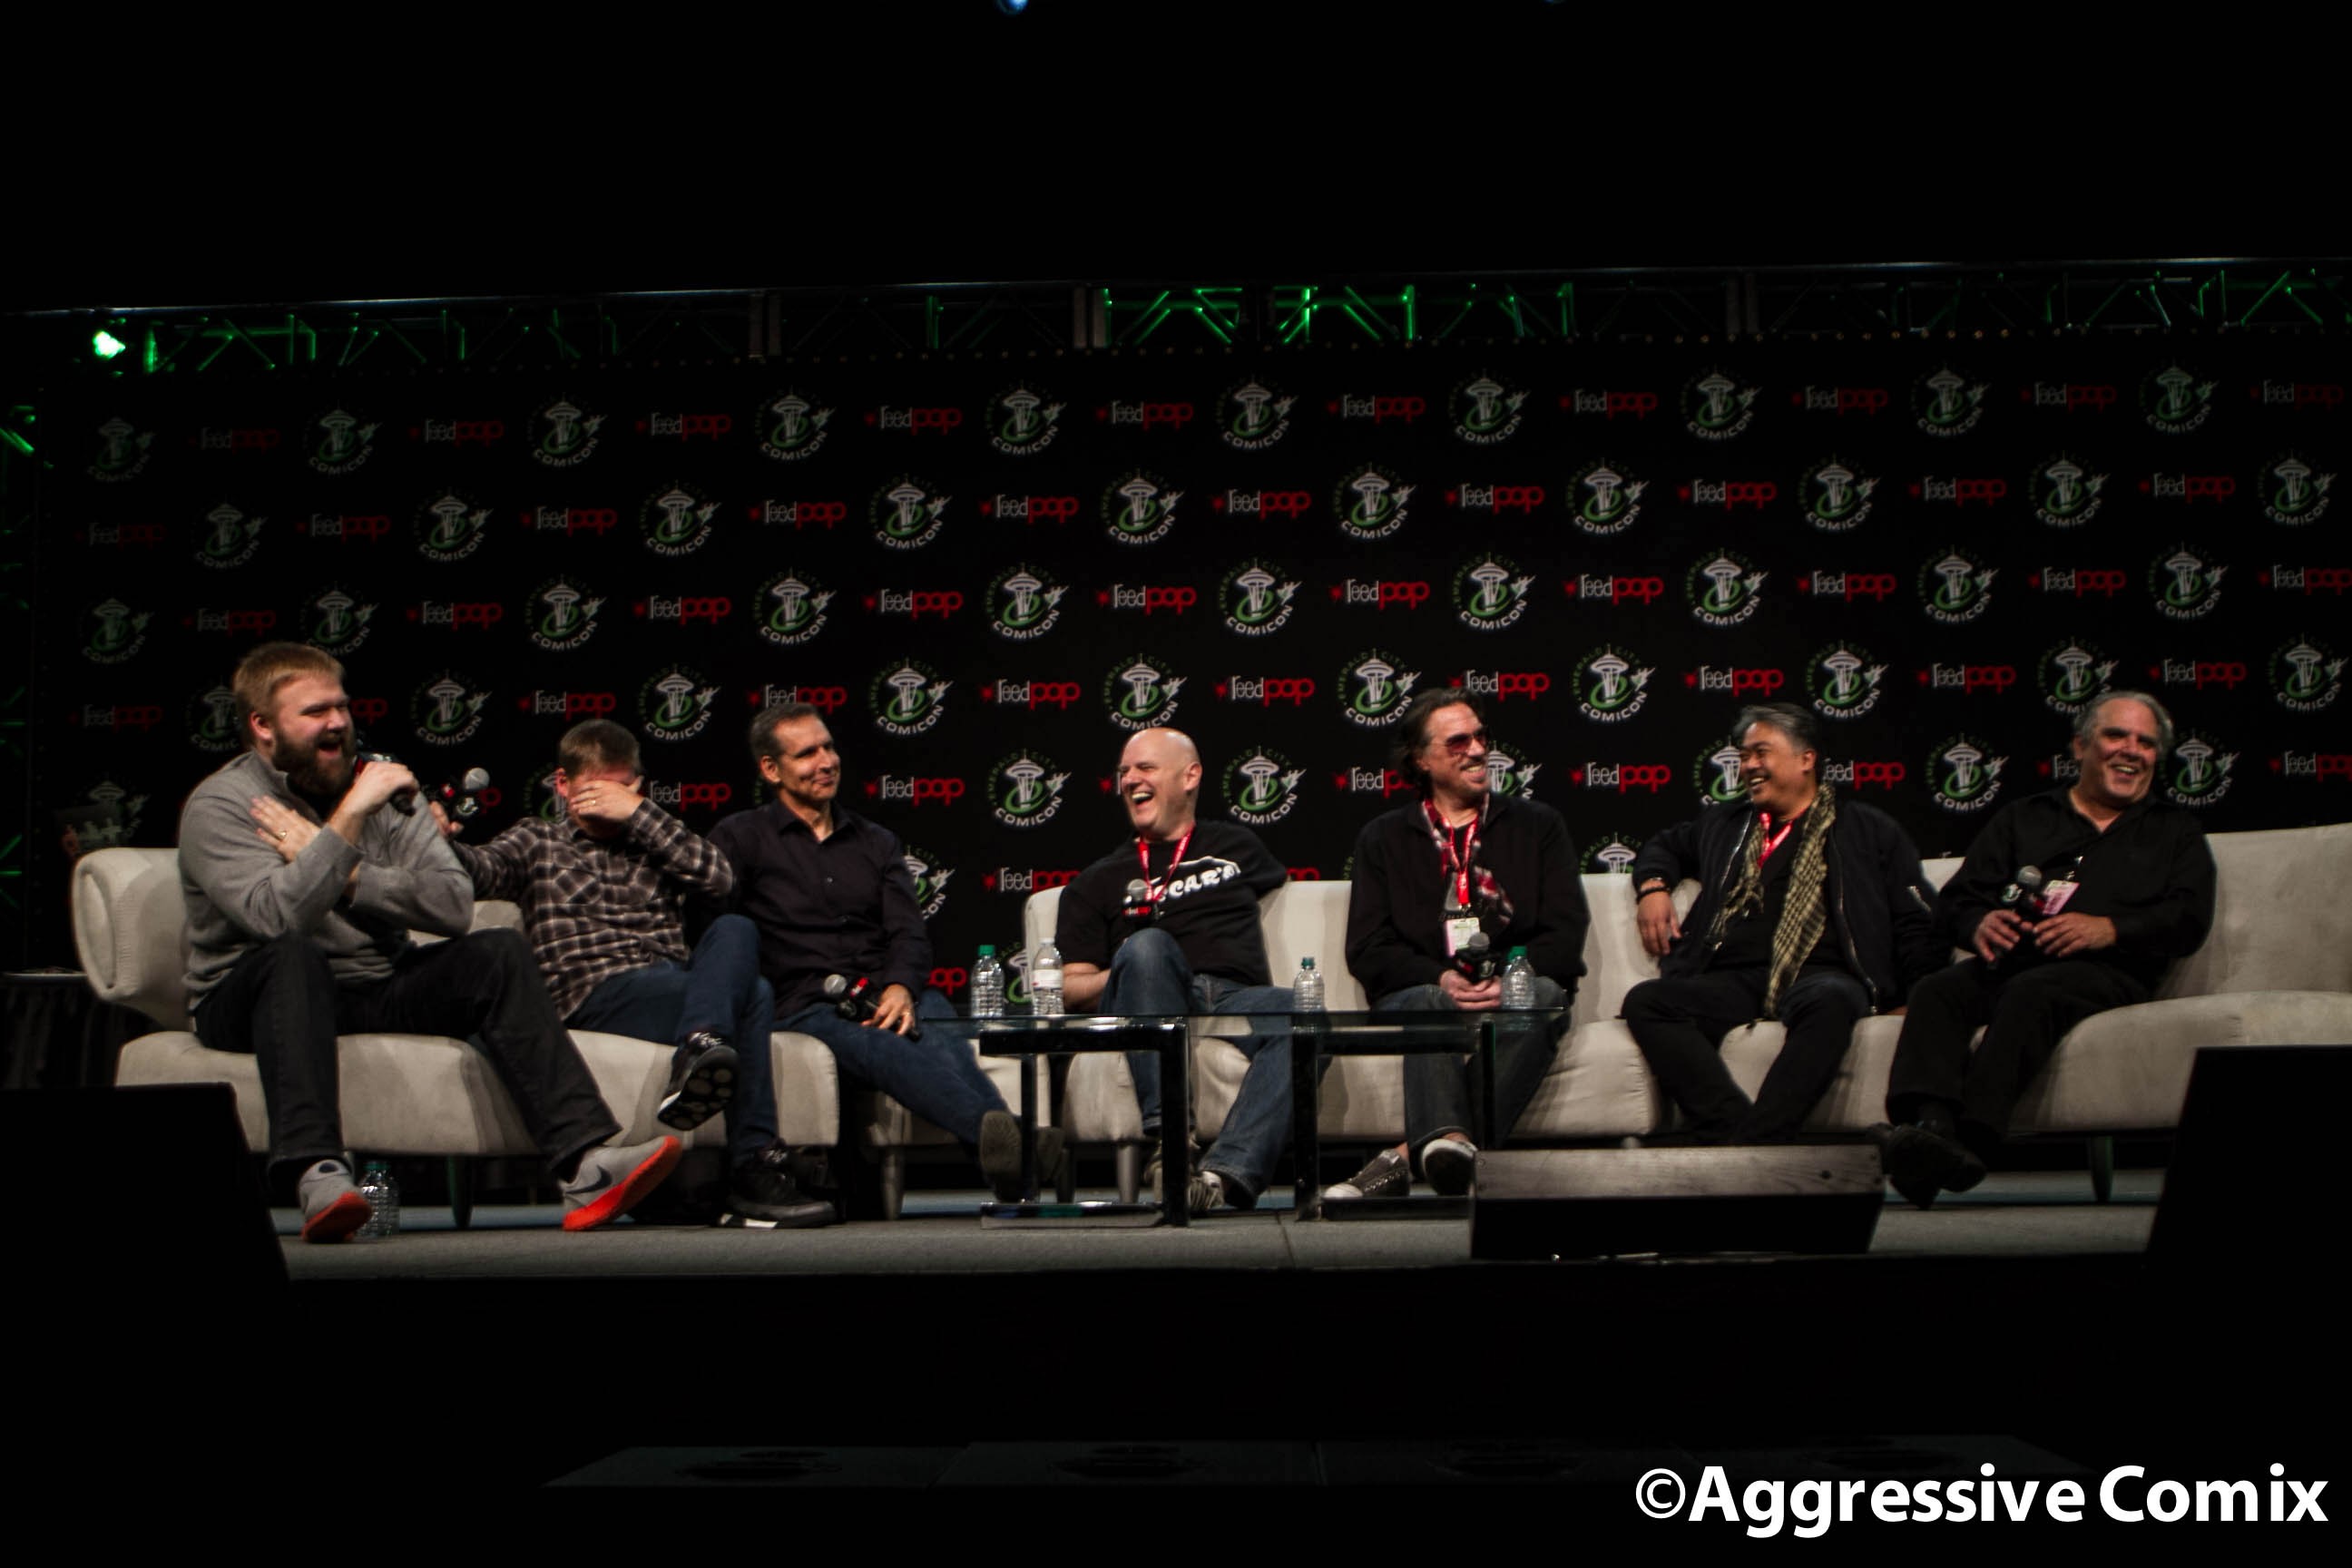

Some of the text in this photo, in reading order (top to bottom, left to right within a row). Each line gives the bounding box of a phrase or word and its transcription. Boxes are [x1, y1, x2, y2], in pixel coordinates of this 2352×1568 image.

[1454, 415, 1524, 446] COMICON
[1685, 410, 1755, 442] COMICON
[1916, 407, 1984, 437] COMICON
[2145, 404, 2211, 434] COMICON
[760, 431, 829, 462] COMICON
[990, 426, 1060, 457] COMICON
[1221, 420, 1291, 452] COMICON
[308, 445, 374, 475] COMICON
[532, 437, 600, 467] COMICON
[1339, 509, 1409, 541] COMICON
[1573, 505, 1642, 536] COMICON
[1804, 501, 1874, 533] COMICON
[2034, 497, 2102, 528] COMICON
[2264, 495, 2330, 525] COMICON
[645, 526, 713, 557] COMICON
[875, 520, 945, 552] COMICON
[1107, 514, 1177, 546] COMICON
[419, 532, 485, 562] COMICON
[1458, 599, 1528, 631] COMICON
[1691, 595, 1761, 627] COMICON
[1924, 593, 1992, 623] COMICON
[2155, 589, 2221, 619] COMICON
[531, 621, 599, 651] COMICON
[759, 614, 828, 645] COMICON
[992, 609, 1062, 641] COMICON
[1224, 605, 1294, 637] COMICON
[1579, 691, 1649, 722] COMICON
[1812, 688, 1882, 719] COMICON
[2275, 681, 2341, 710] COMICON
[644, 710, 712, 741] COMICON
[876, 704, 946, 736] COMICON
[1110, 701, 1179, 729] COMICON
[1344, 696, 1414, 728] COMICON
[191, 732, 240, 751] COMIC
[416, 715, 483, 745] COMICON
[1933, 780, 2001, 811] COMICON
[2168, 776, 2234, 807] COMICON
[994, 796, 1063, 828] COMICON
[1229, 793, 1298, 825] COMICON
